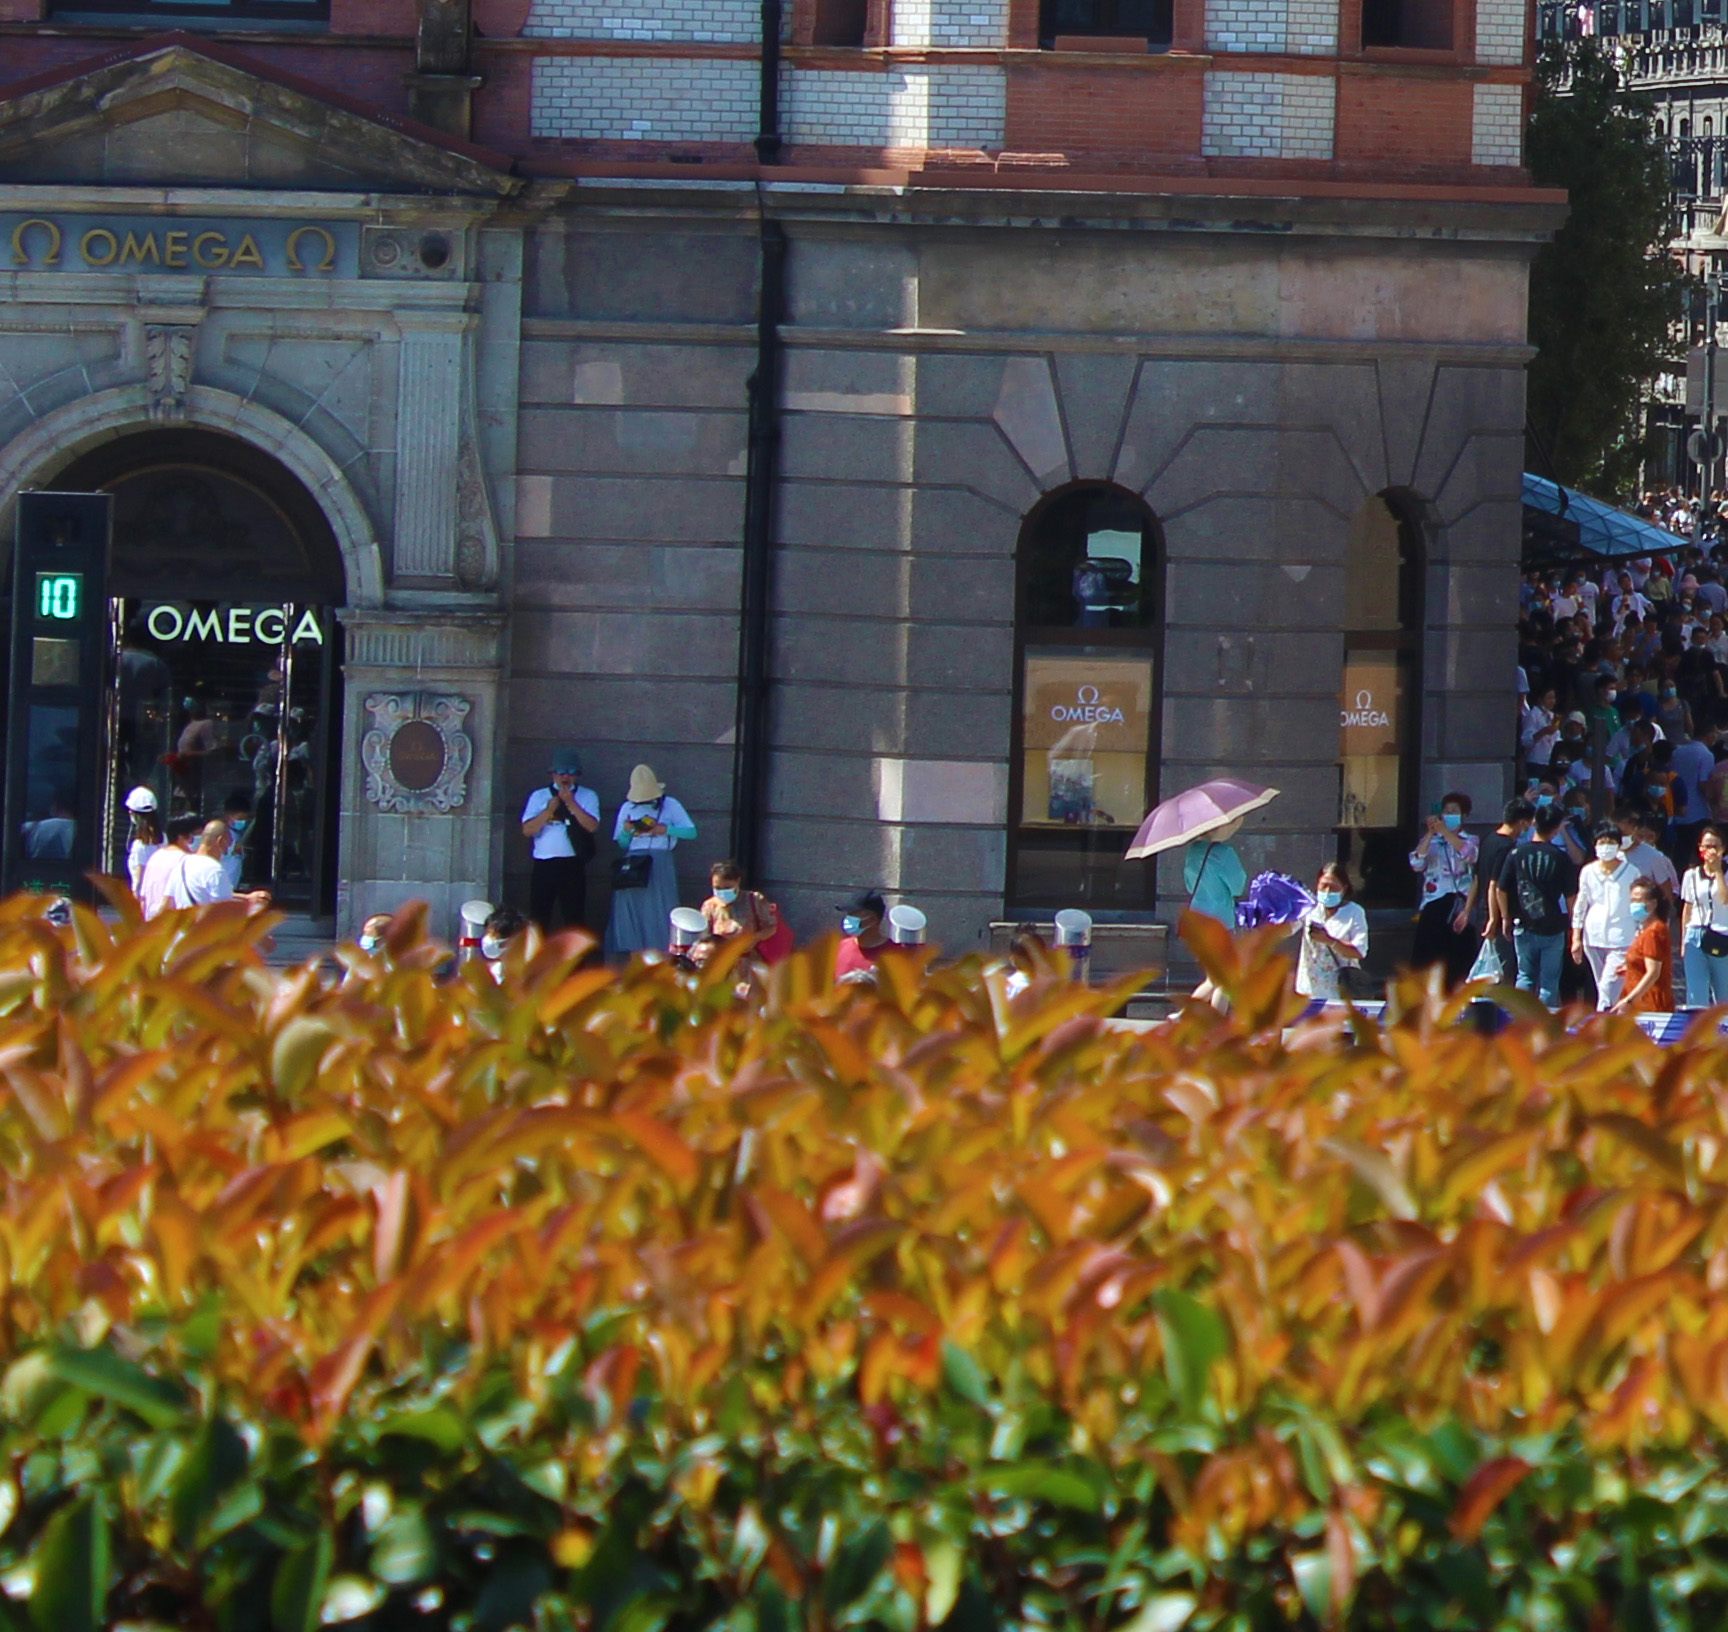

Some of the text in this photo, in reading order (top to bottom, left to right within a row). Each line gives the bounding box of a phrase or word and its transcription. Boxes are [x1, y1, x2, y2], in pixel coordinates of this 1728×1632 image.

[79, 227, 264, 269] OMEGA
[41, 577, 77, 619] 10
[147, 605, 324, 646] OMEGA
[1050, 705, 1125, 724] OMEGA
[1340, 710, 1390, 727] OMEGA
